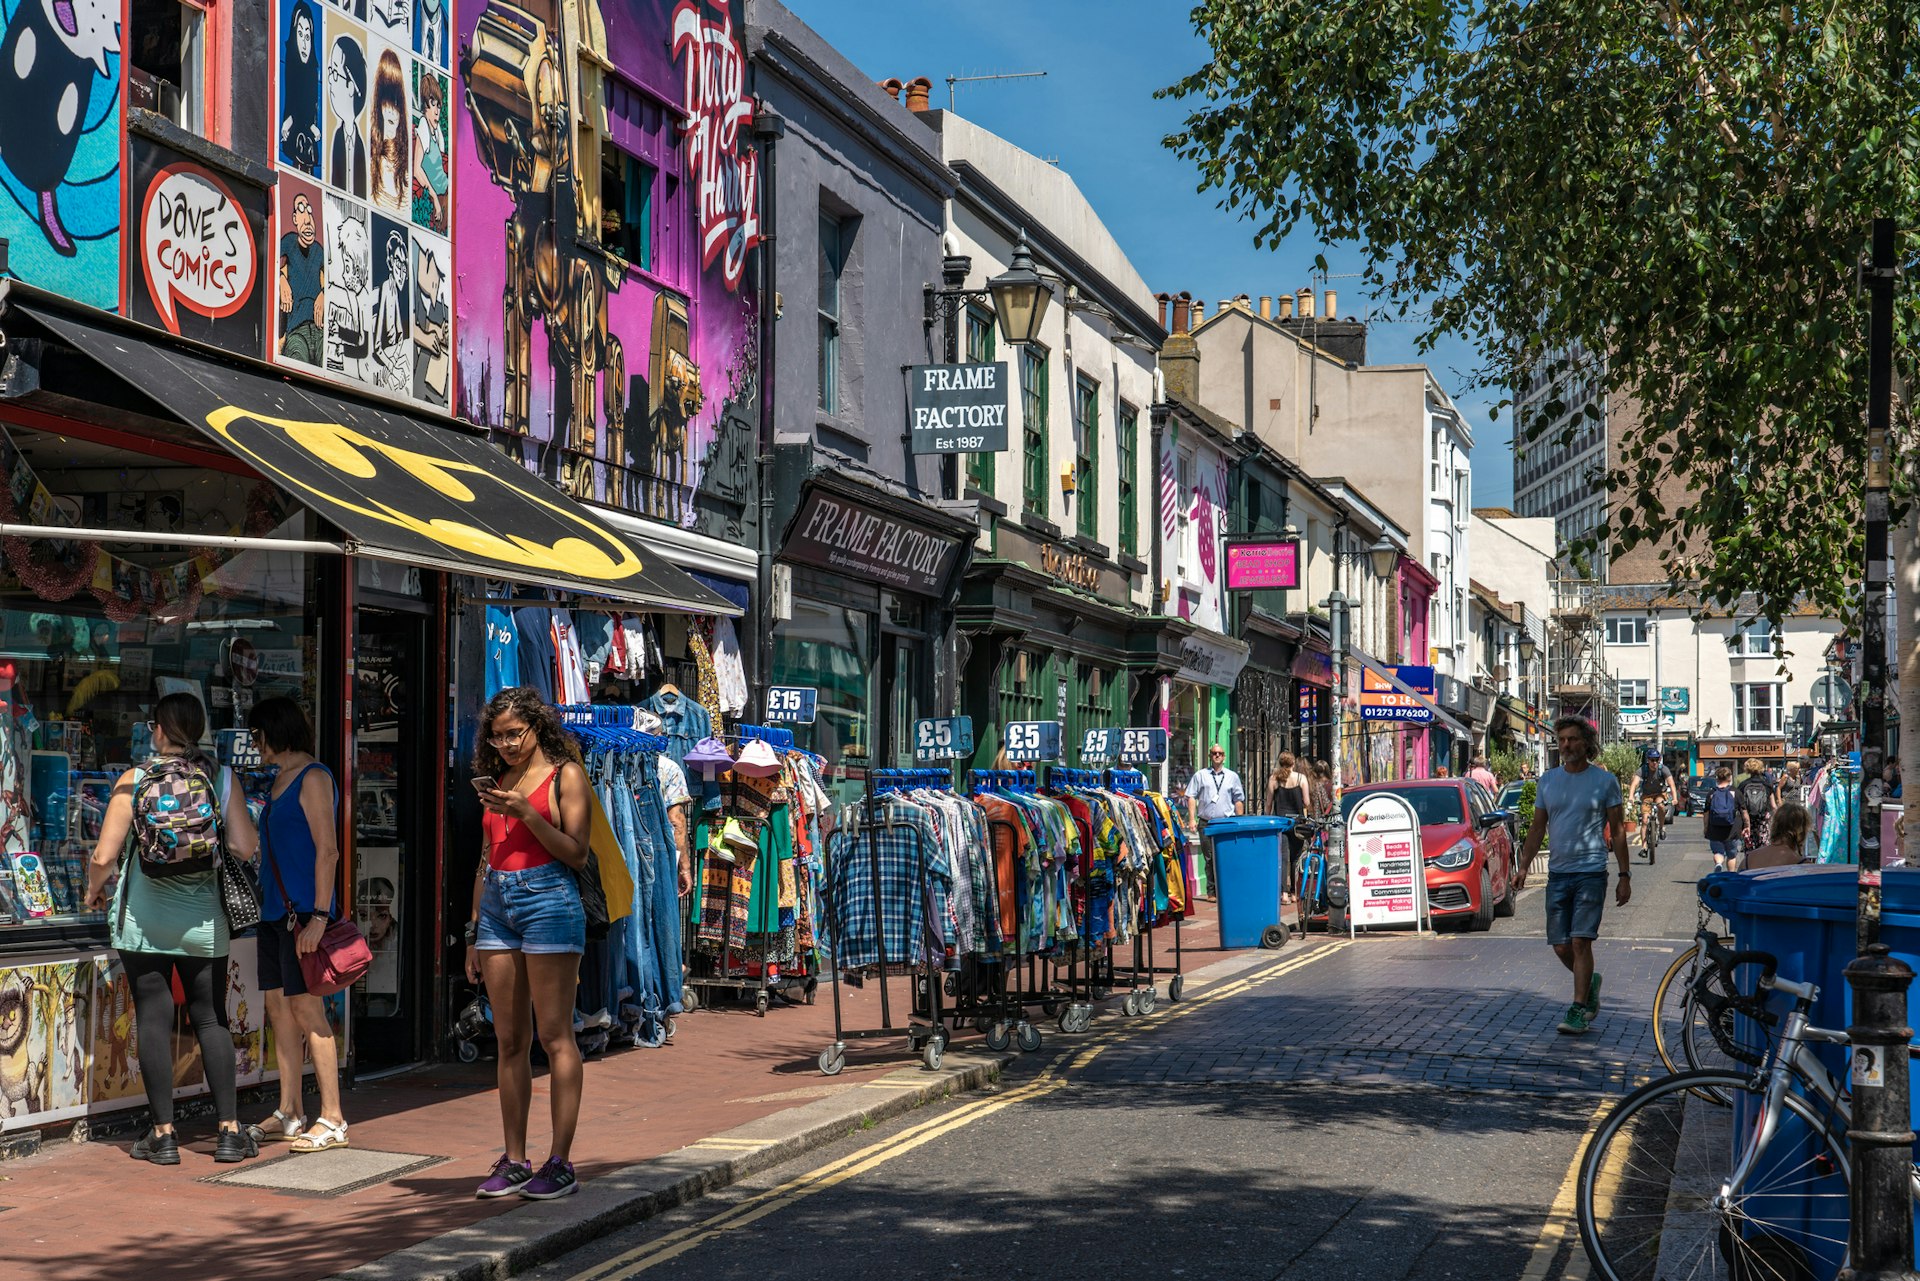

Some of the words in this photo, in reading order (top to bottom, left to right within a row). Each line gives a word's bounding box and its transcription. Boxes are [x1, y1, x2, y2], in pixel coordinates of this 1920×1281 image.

[690, 114, 757, 281] Harry
[924, 366, 996, 391] FRAME
[915, 404, 1006, 430] FACTORY
[936, 438, 954, 449] Est
[956, 436, 984, 449] 1987
[802, 498, 882, 556] FRAME
[871, 521, 952, 576] FACTORY
[769, 690, 801, 710] £15
[1381, 695, 1396, 705] TO
[768, 711, 799, 720] RAIL
[1365, 708, 1394, 717] 01273
[1395, 708, 1430, 718] 876200
[918, 719, 952, 747] £5
[1009, 724, 1040, 749] £5
[1084, 729, 1109, 752] £5
[1123, 730, 1150, 752] £5
[1006, 749, 1041, 760] RAIL
[1121, 753, 1151, 761] RAIL
